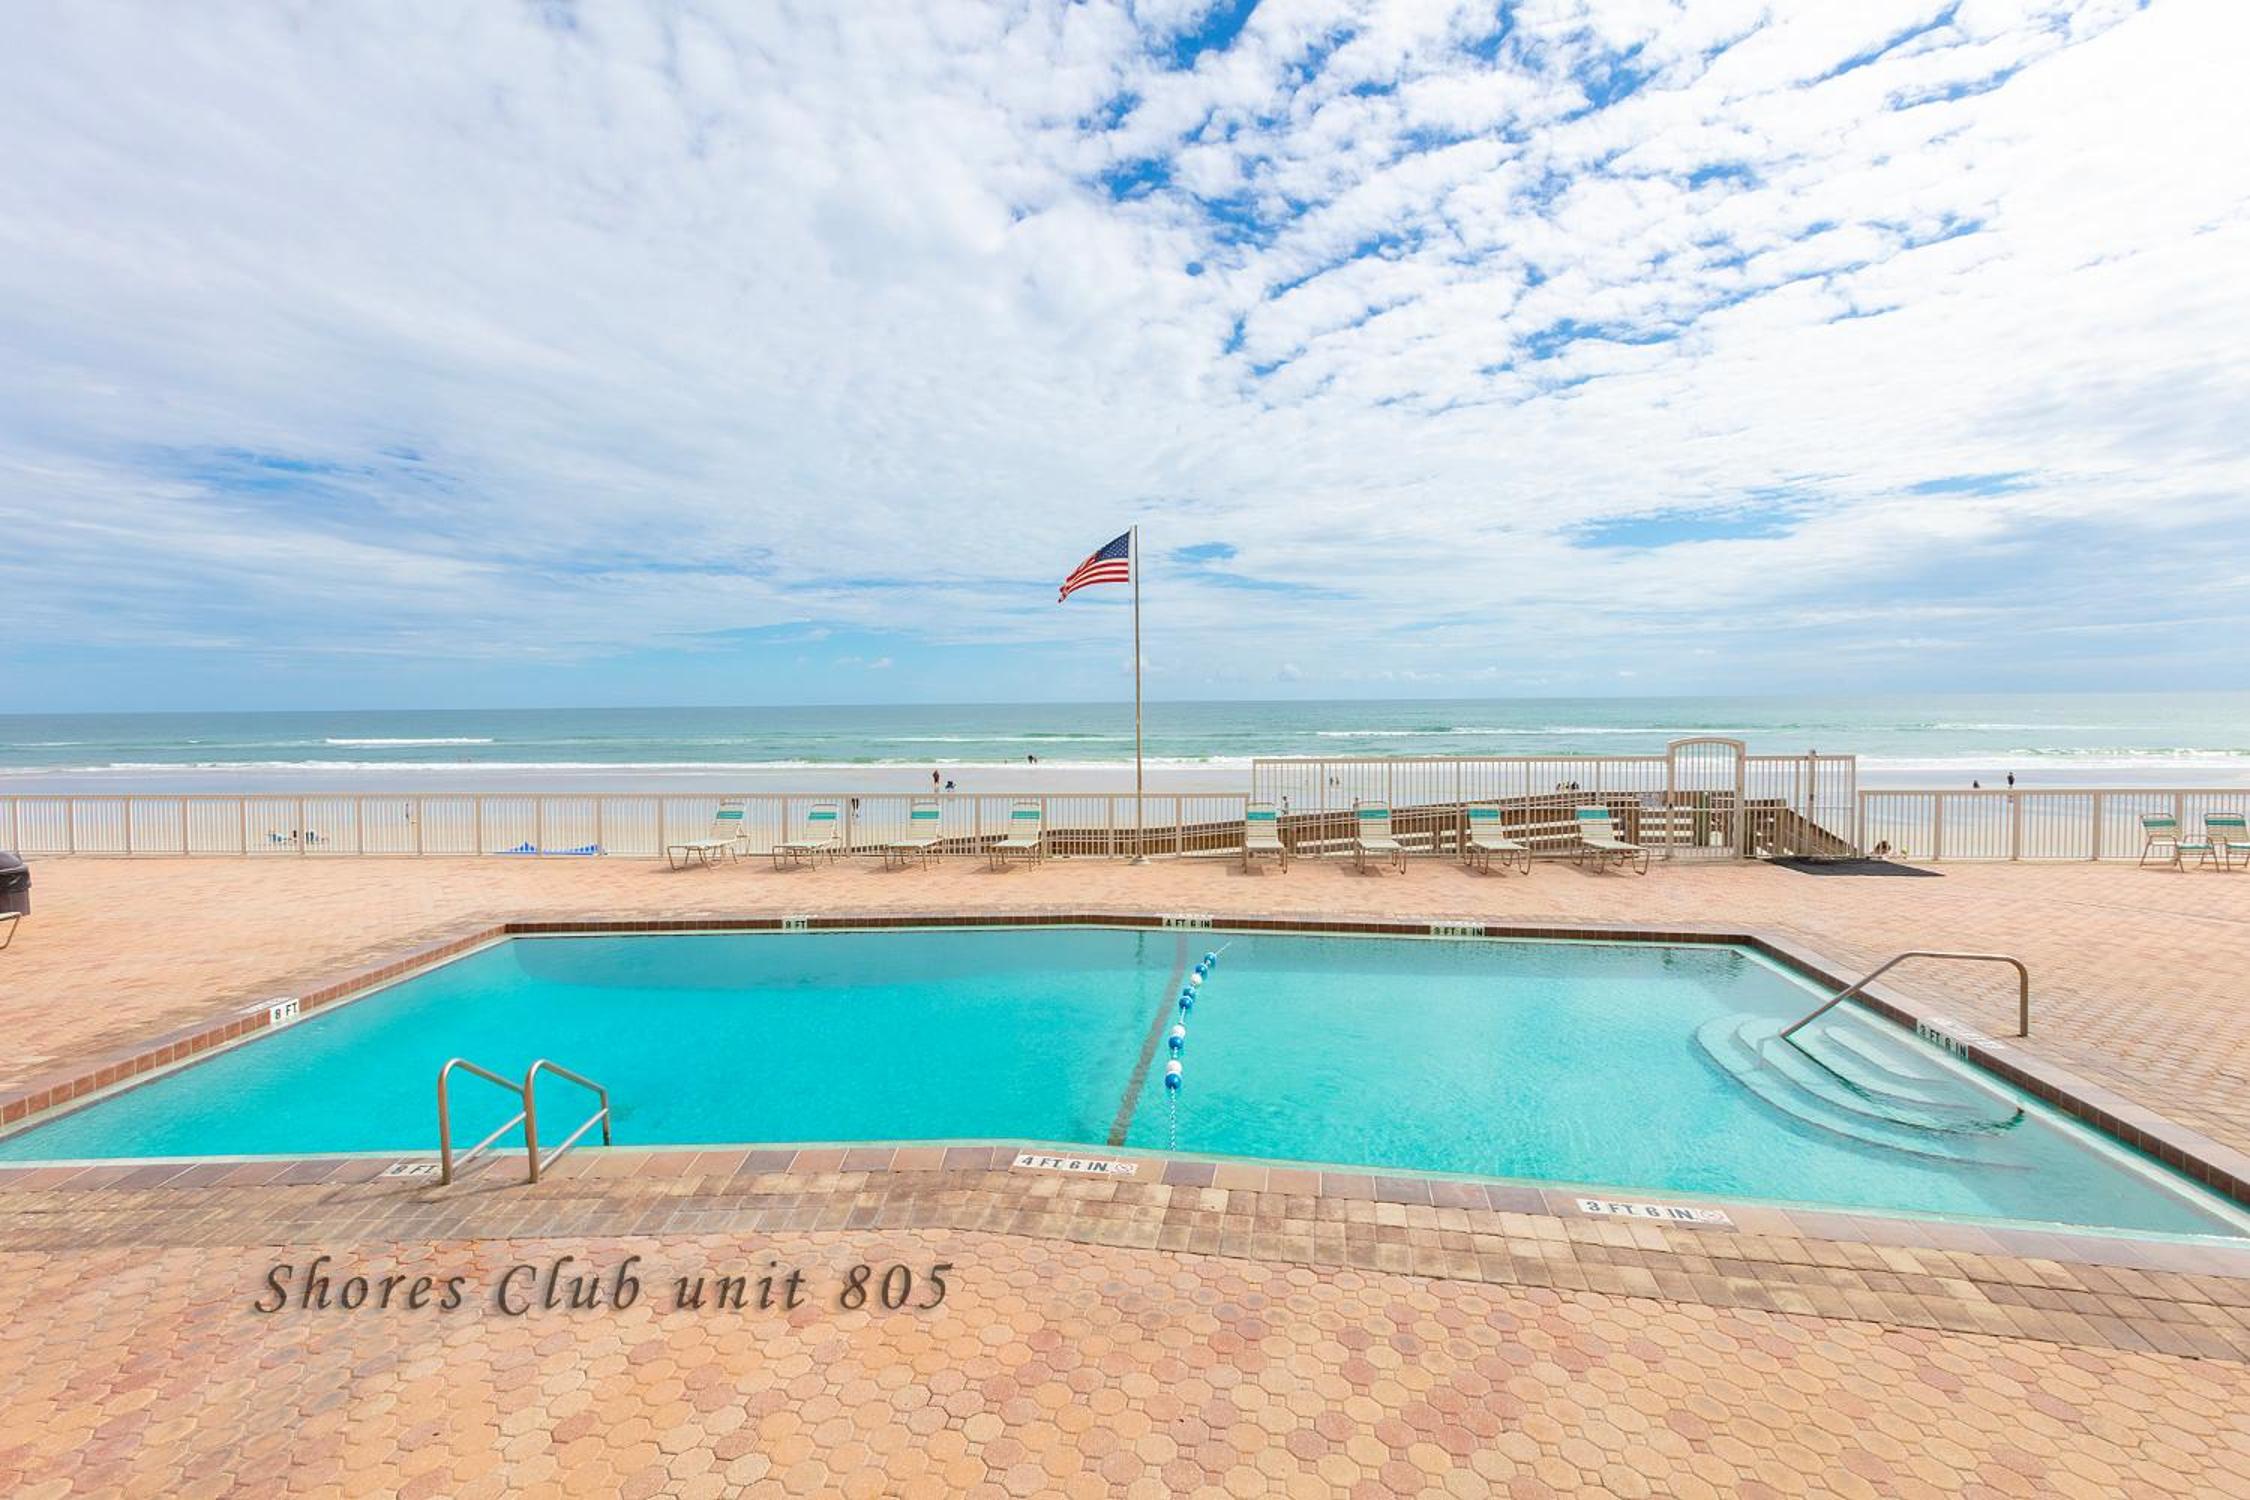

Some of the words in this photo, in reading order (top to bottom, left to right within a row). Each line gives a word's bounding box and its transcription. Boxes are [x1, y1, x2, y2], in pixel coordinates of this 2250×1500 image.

[1200, 920, 1210, 928] IN
[275, 1008, 281, 1020] 8
[286, 1001, 298, 1016] FT
[1930, 1029, 1940, 1043] FT
[1955, 1042, 1966, 1057] IN
[409, 1165, 438, 1174] FT
[1021, 1156, 1033, 1166] 4
[1039, 1158, 1062, 1168] FT
[1069, 1160, 1081, 1169] 6
[1087, 1161, 1109, 1171] IN
[1587, 1201, 1600, 1211] 3
[1607, 1203, 1634, 1214] FT
[1645, 1207, 1661, 1217] 6
[1667, 1208, 1694, 1220] IN
